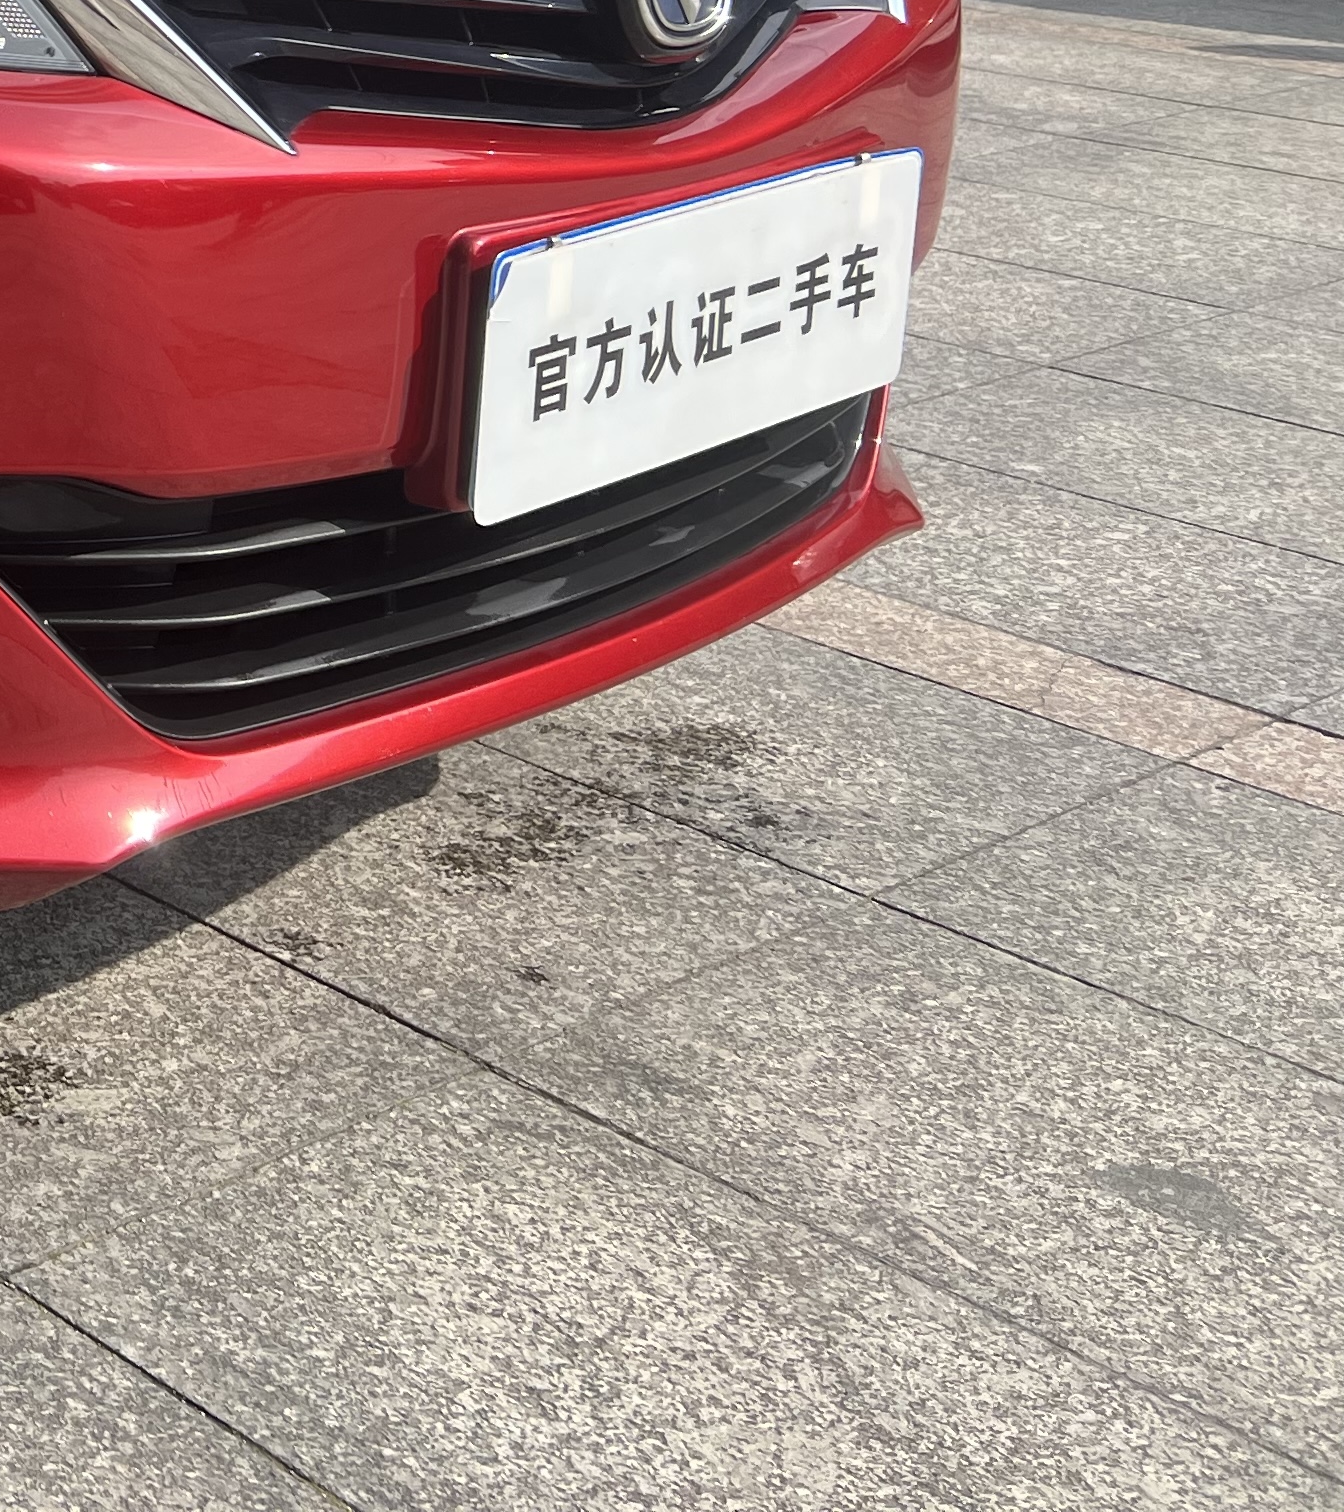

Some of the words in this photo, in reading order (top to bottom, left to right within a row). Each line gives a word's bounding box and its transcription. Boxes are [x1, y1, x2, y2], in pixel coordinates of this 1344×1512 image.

[528, 244, 878, 422] 官方认证二手车
